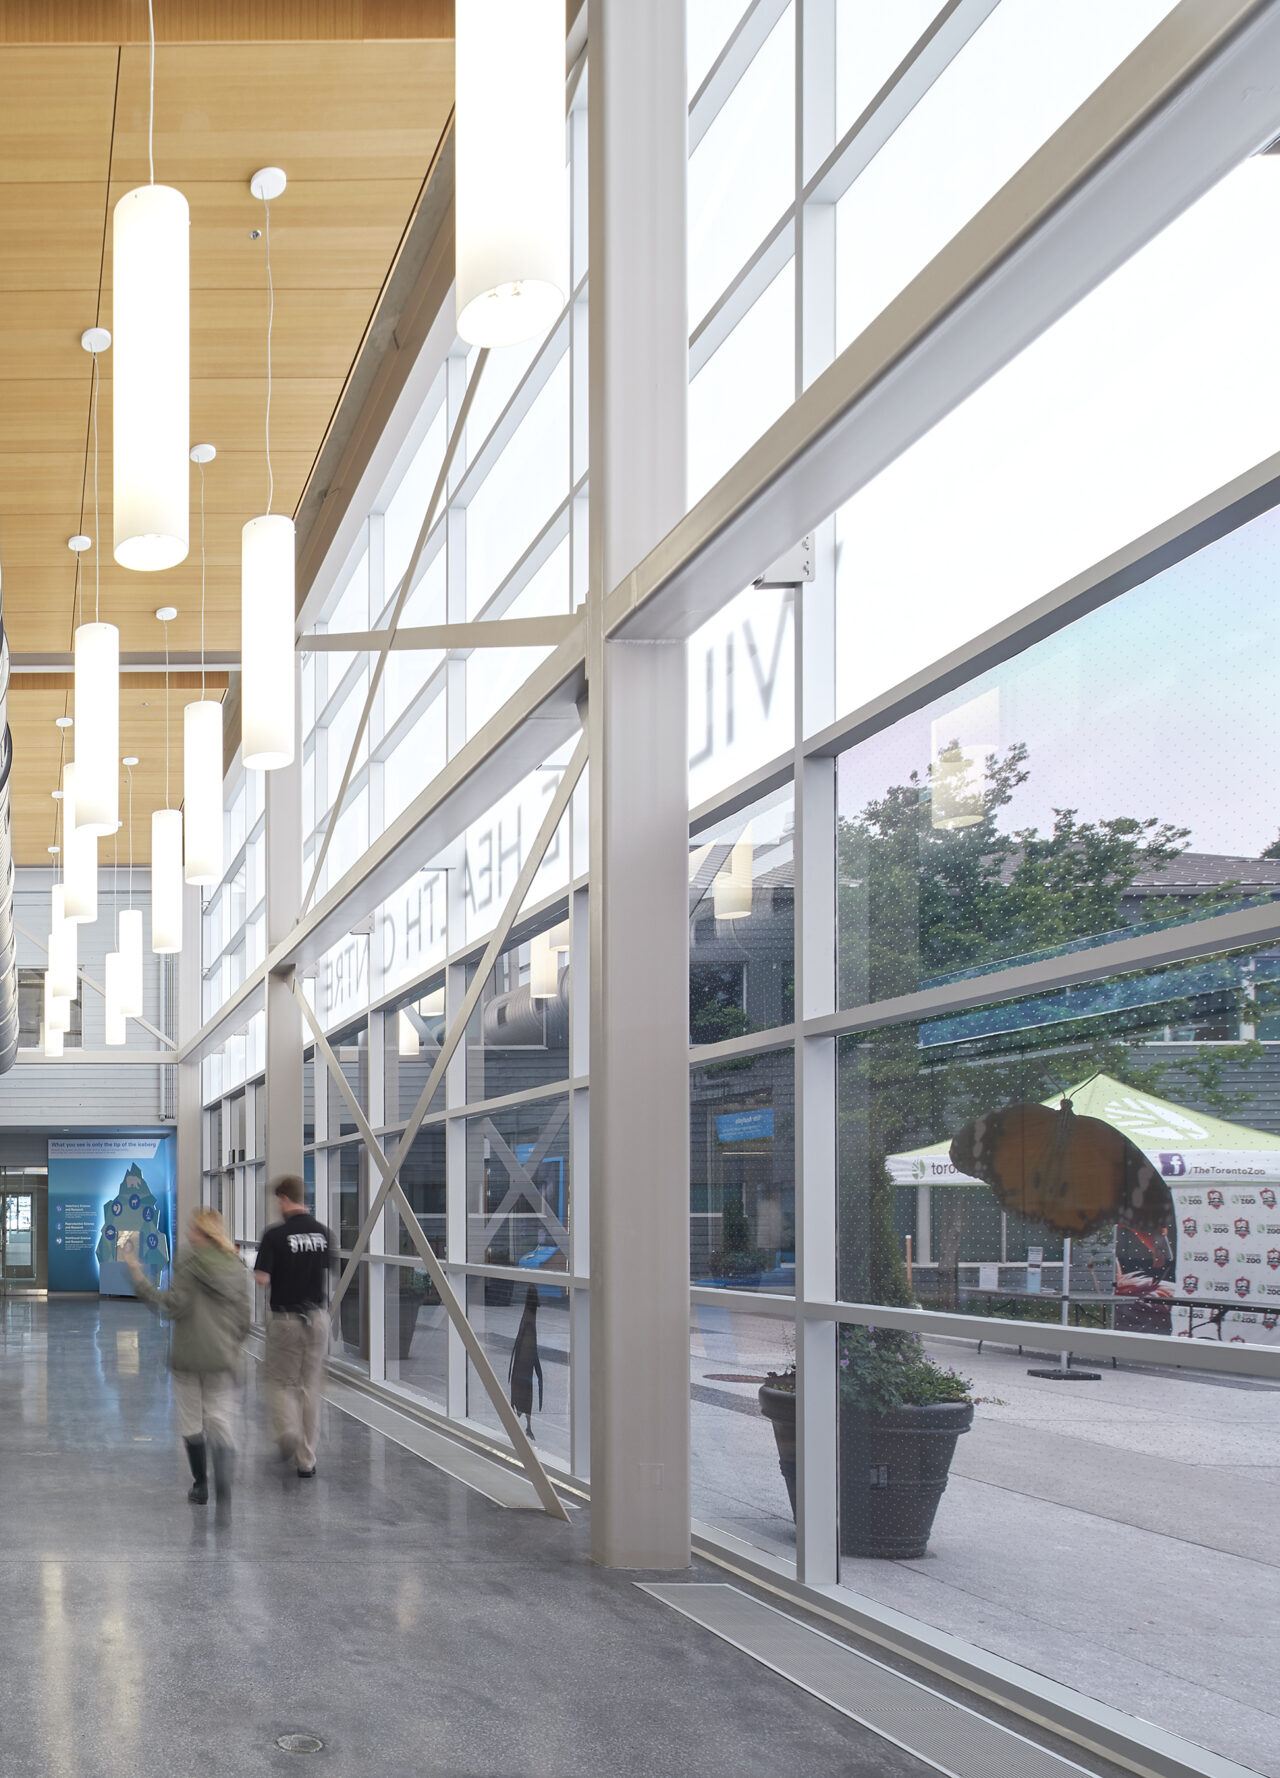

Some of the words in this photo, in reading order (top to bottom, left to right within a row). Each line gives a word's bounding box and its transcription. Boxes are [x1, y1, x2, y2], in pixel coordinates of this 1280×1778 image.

[931, 1161, 960, 1175] toro
[1188, 1166, 1266, 1175] /TheTorontoZoo
[287, 1232, 328, 1253] STAFF
